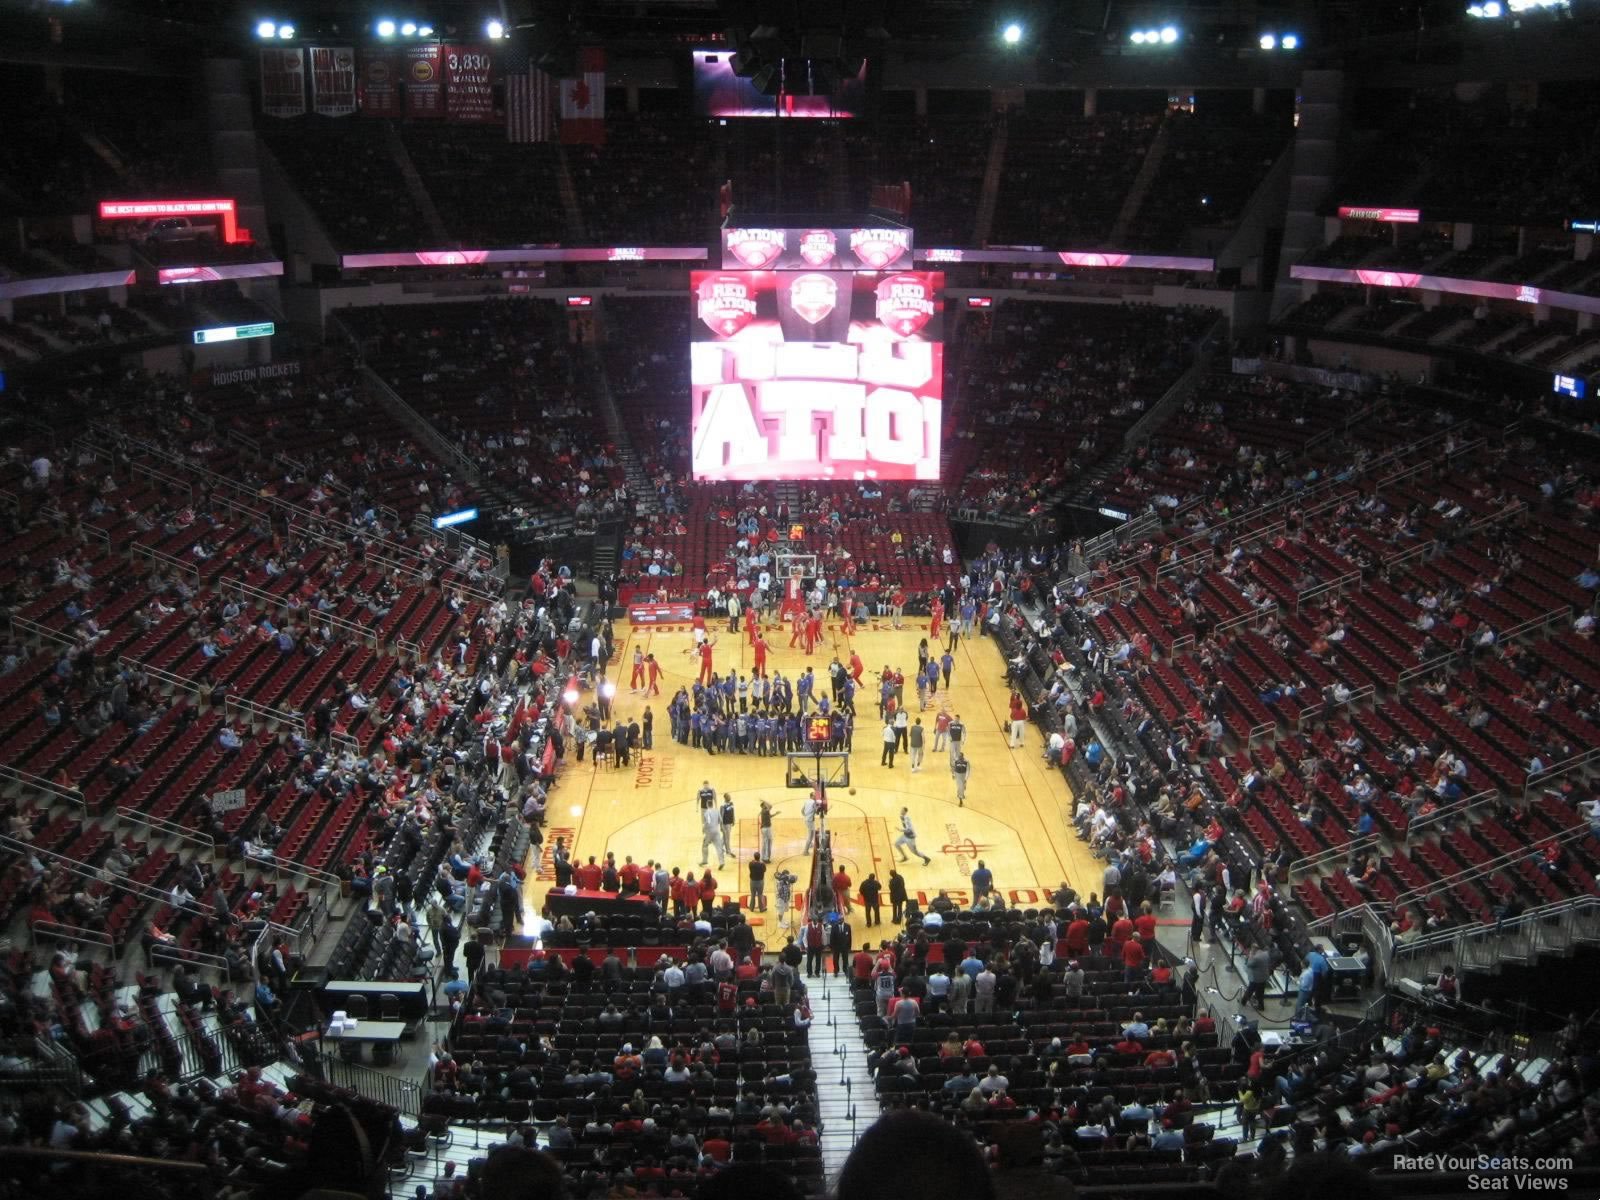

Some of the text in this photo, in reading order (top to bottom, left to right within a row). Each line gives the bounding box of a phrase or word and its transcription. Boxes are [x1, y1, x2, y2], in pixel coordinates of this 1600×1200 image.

[448, 54, 491, 73] 3,830
[727, 229, 786, 250] NATION
[850, 229, 909, 251] NATION
[712, 283, 747, 298] RED
[890, 283, 925, 299] RED
[698, 297, 757, 319] NATION
[876, 297, 935, 319] NATION
[213, 362, 301, 386] HOUSTON ROCKETS
[810, 726, 827, 739] 24
[812, 719, 828, 727] 2:04
